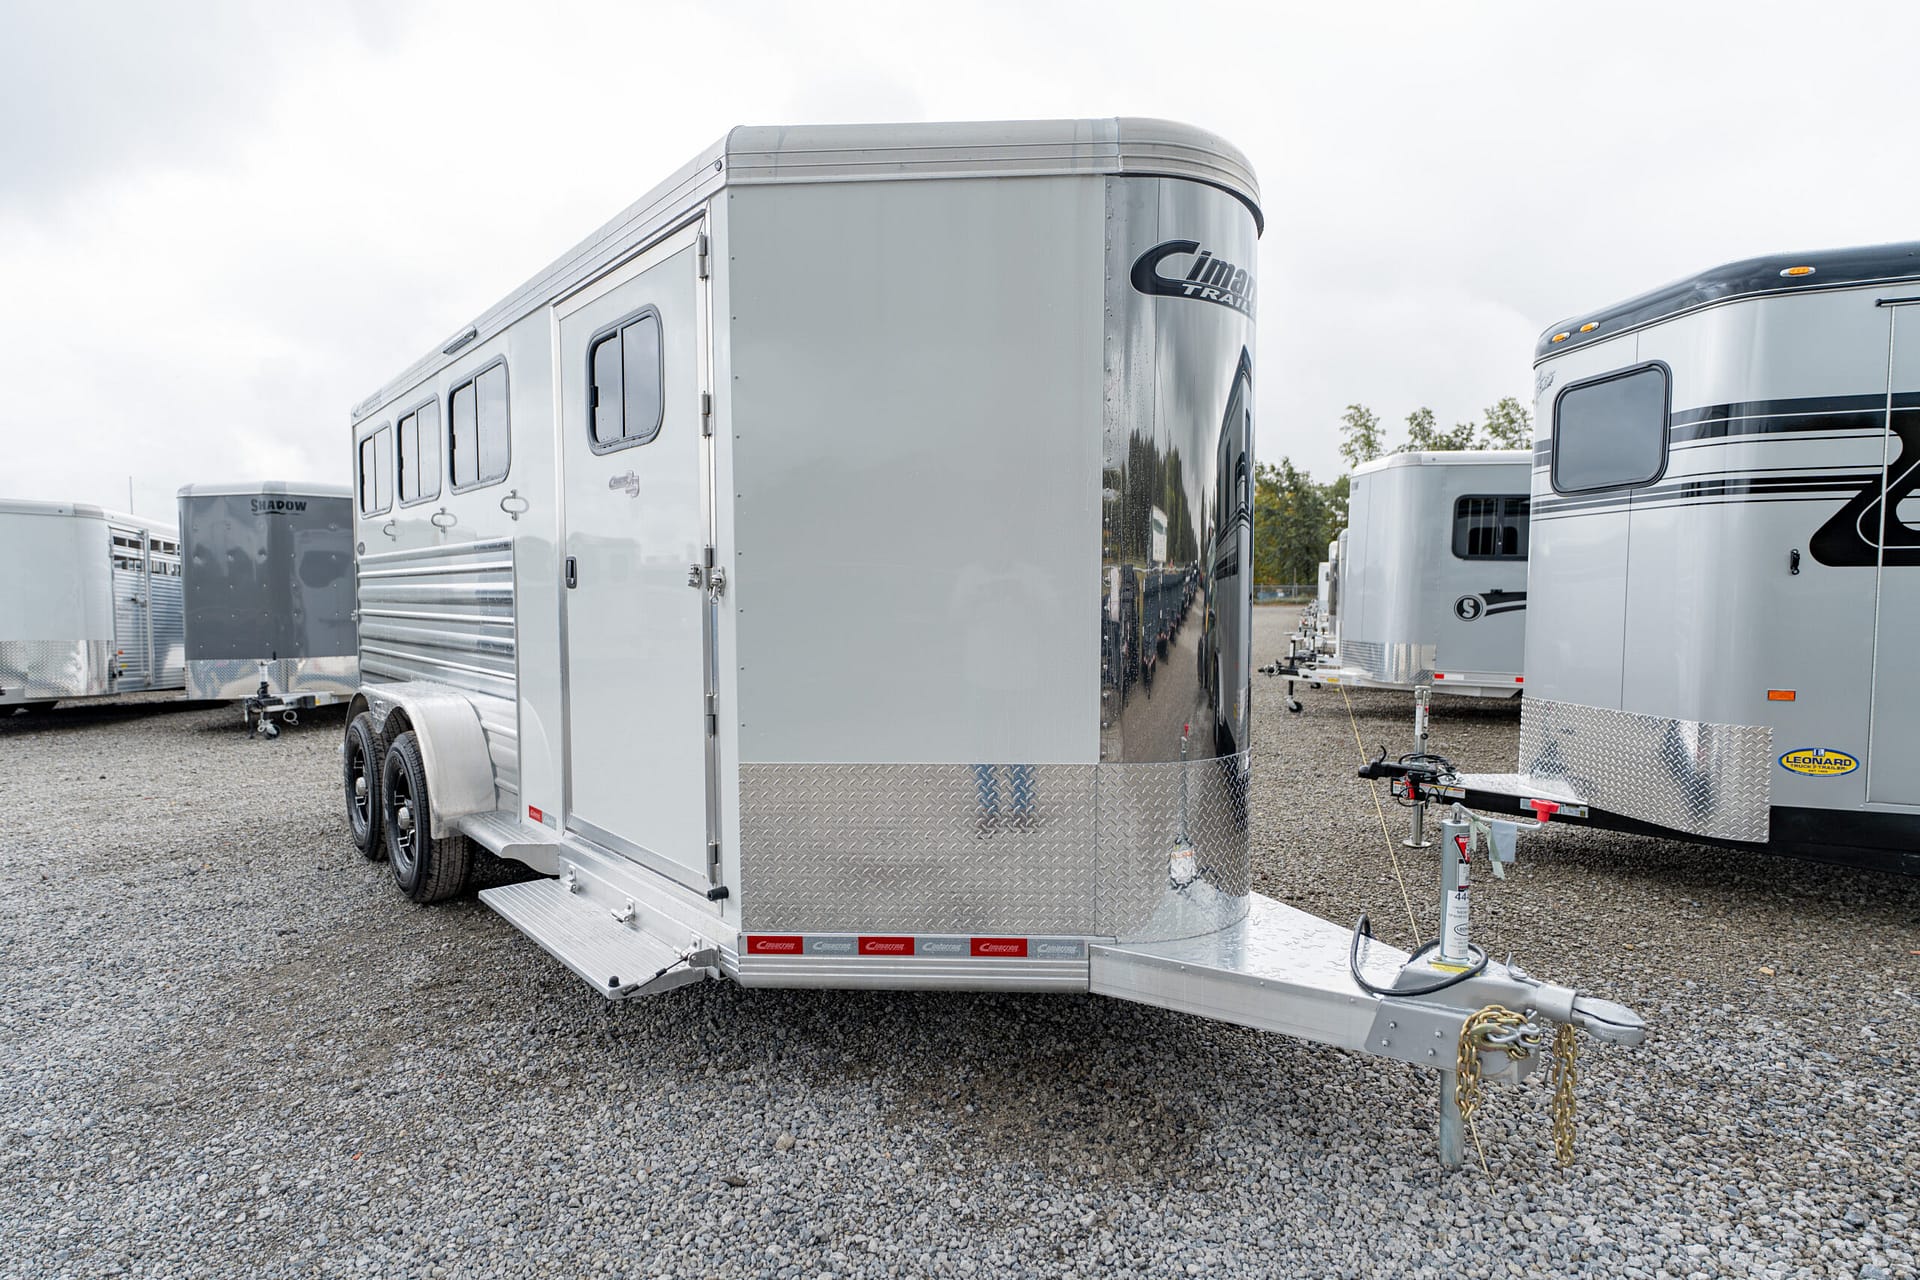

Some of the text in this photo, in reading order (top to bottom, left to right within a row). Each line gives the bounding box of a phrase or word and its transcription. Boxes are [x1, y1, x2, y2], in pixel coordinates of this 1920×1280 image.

[250, 498, 307, 512] SHADOW
[1462, 599, 1475, 618] S
[1785, 756, 1852, 767] LEONARD
[979, 942, 1020, 953] Cimarron
